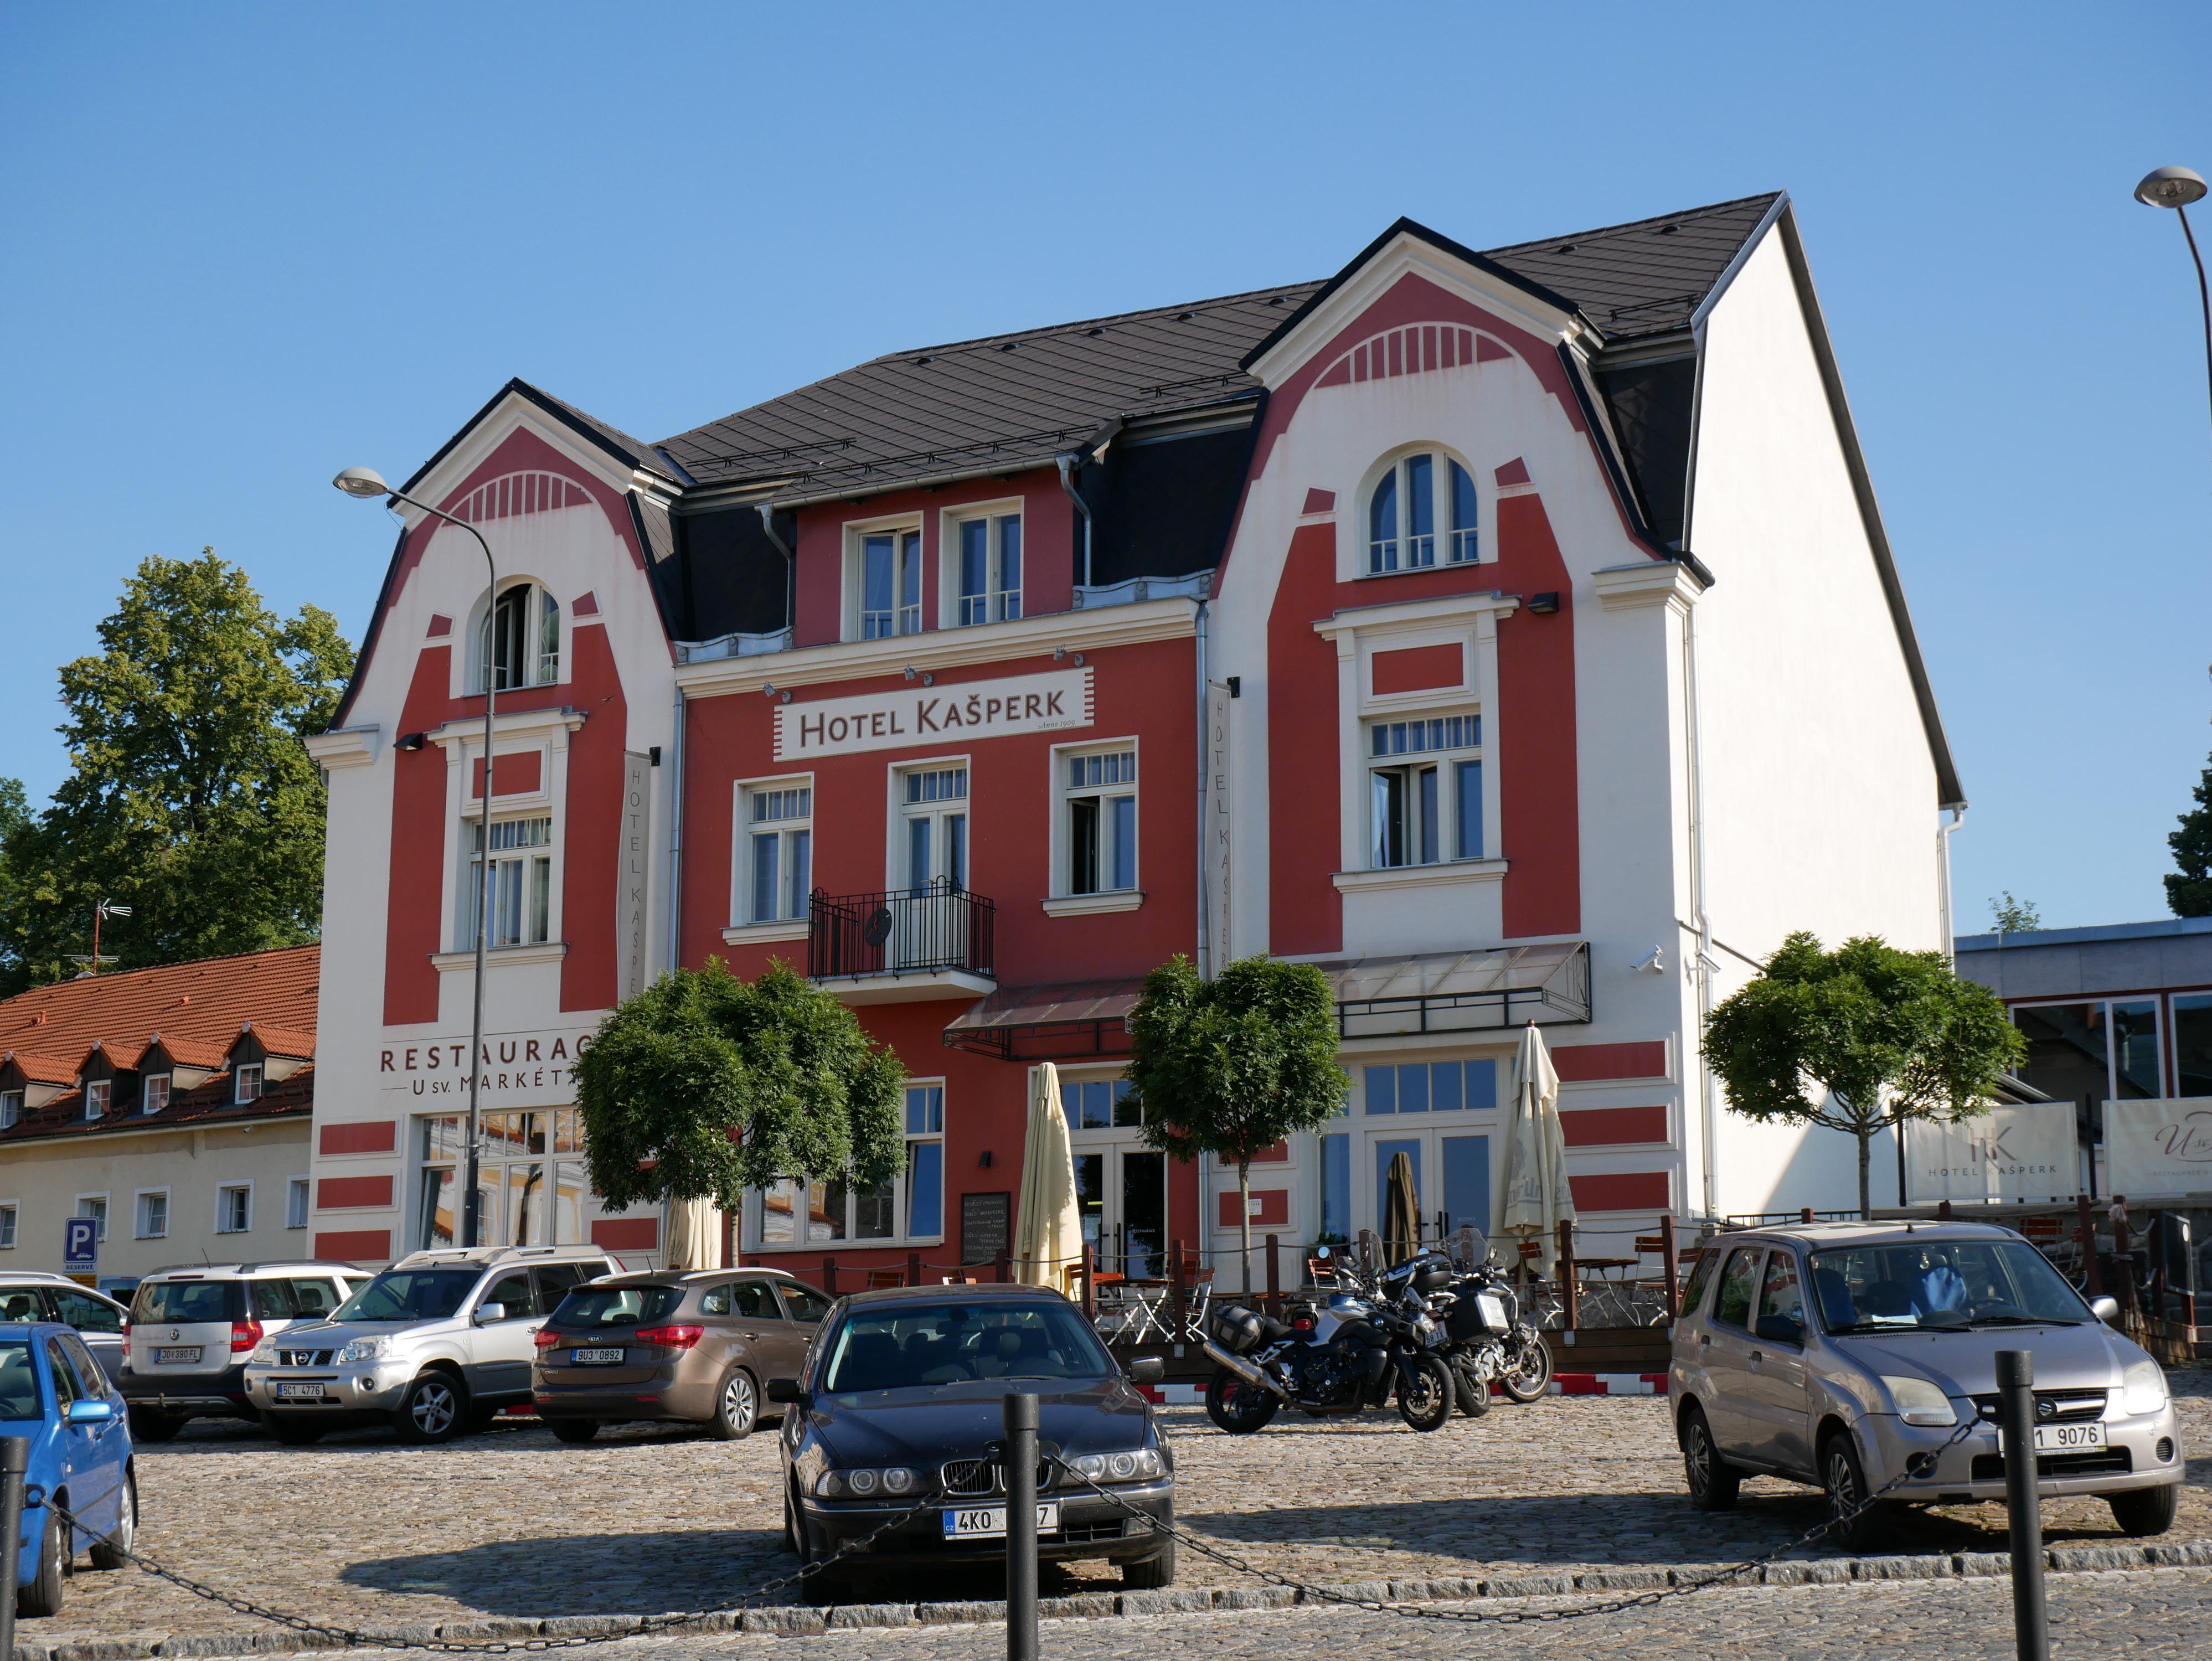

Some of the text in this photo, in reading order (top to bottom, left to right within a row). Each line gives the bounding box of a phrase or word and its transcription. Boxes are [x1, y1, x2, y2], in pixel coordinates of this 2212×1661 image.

[801, 690, 1065, 747] HOTEL KAŠPERK
[1215, 701, 1229, 968] HOTEL KAŠPER
[630, 770, 641, 993] HOTEL KAŠPE
[380, 1034, 593, 1072] RESTAURAC
[413, 1080, 424, 1095] U
[1929, 1165, 2056, 1177] HOTEL KAŠPERK
[71, 1225, 90, 1253] P
[176, 1350, 188, 1358] 390
[189, 1349, 197, 1358] FL
[578, 1350, 620, 1360] 9U3 0892
[283, 1386, 320, 1395] 5C1 4776
[2058, 1427, 2097, 1445] 9076
